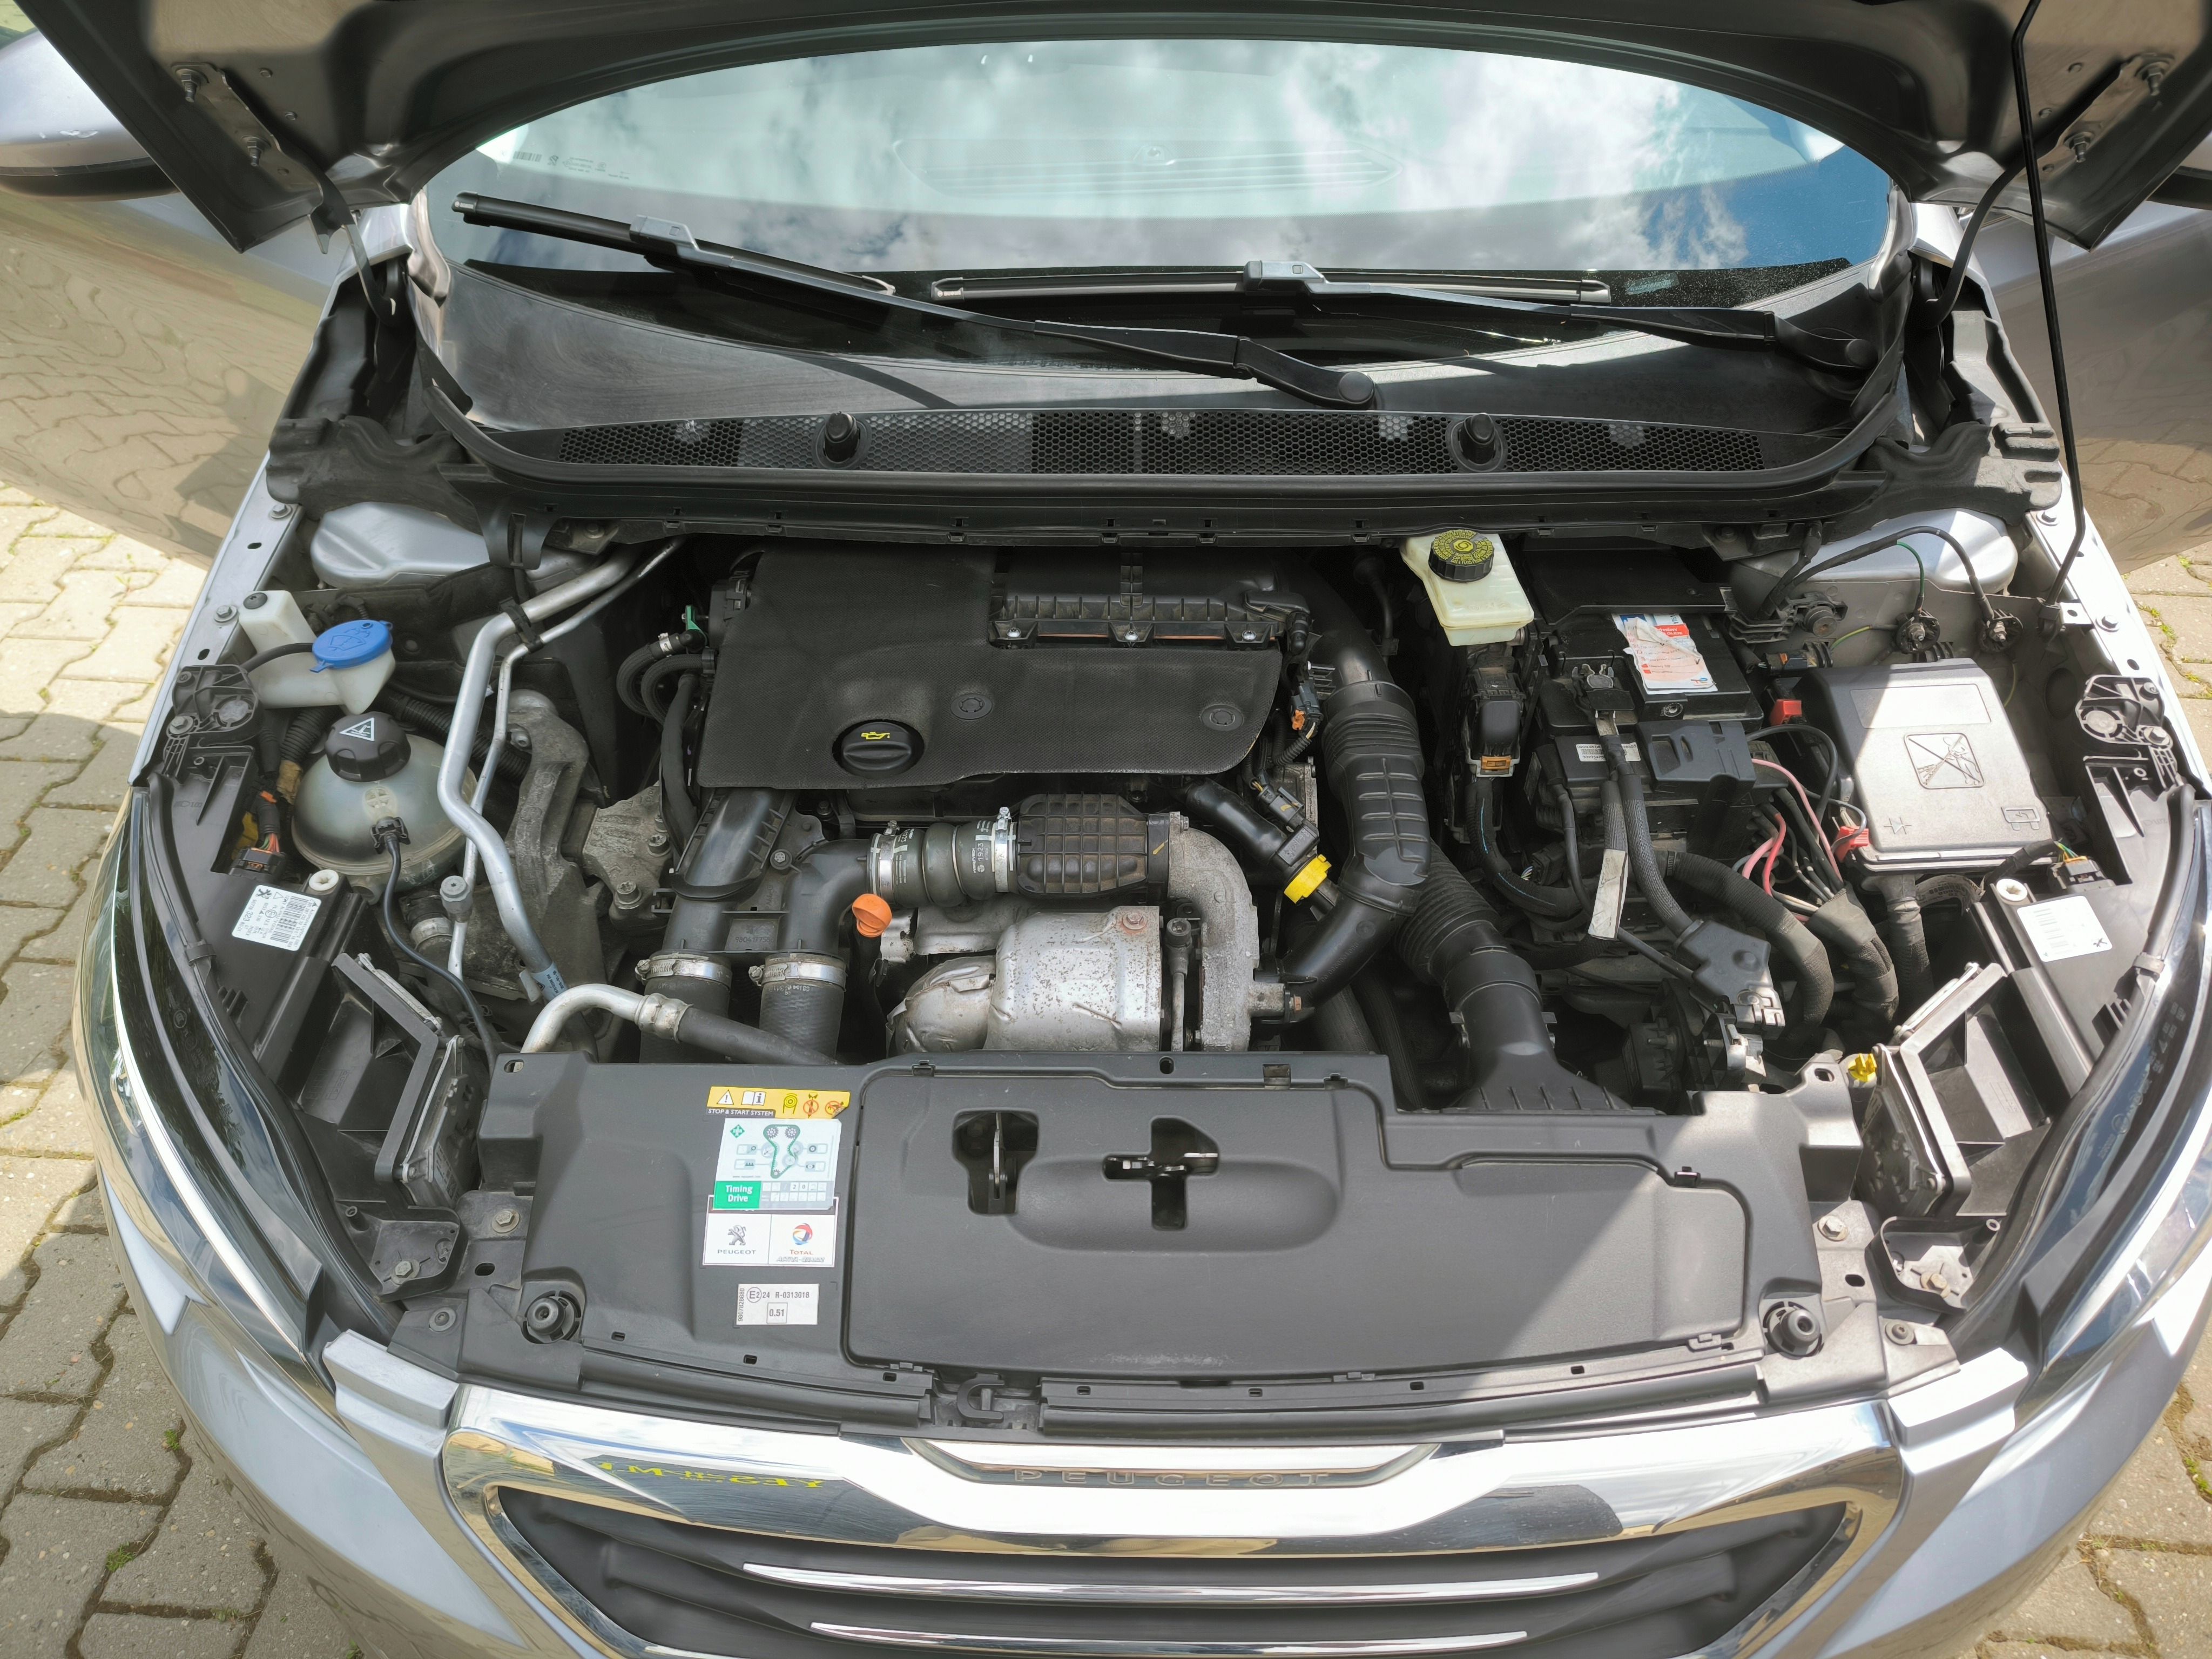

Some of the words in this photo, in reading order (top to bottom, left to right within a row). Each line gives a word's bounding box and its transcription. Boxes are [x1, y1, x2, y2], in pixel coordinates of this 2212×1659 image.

[242, 911, 254, 921] 323
[725, 1185, 753, 1195] Timing
[1014, 1468, 1329, 1487] PEUGEOT
